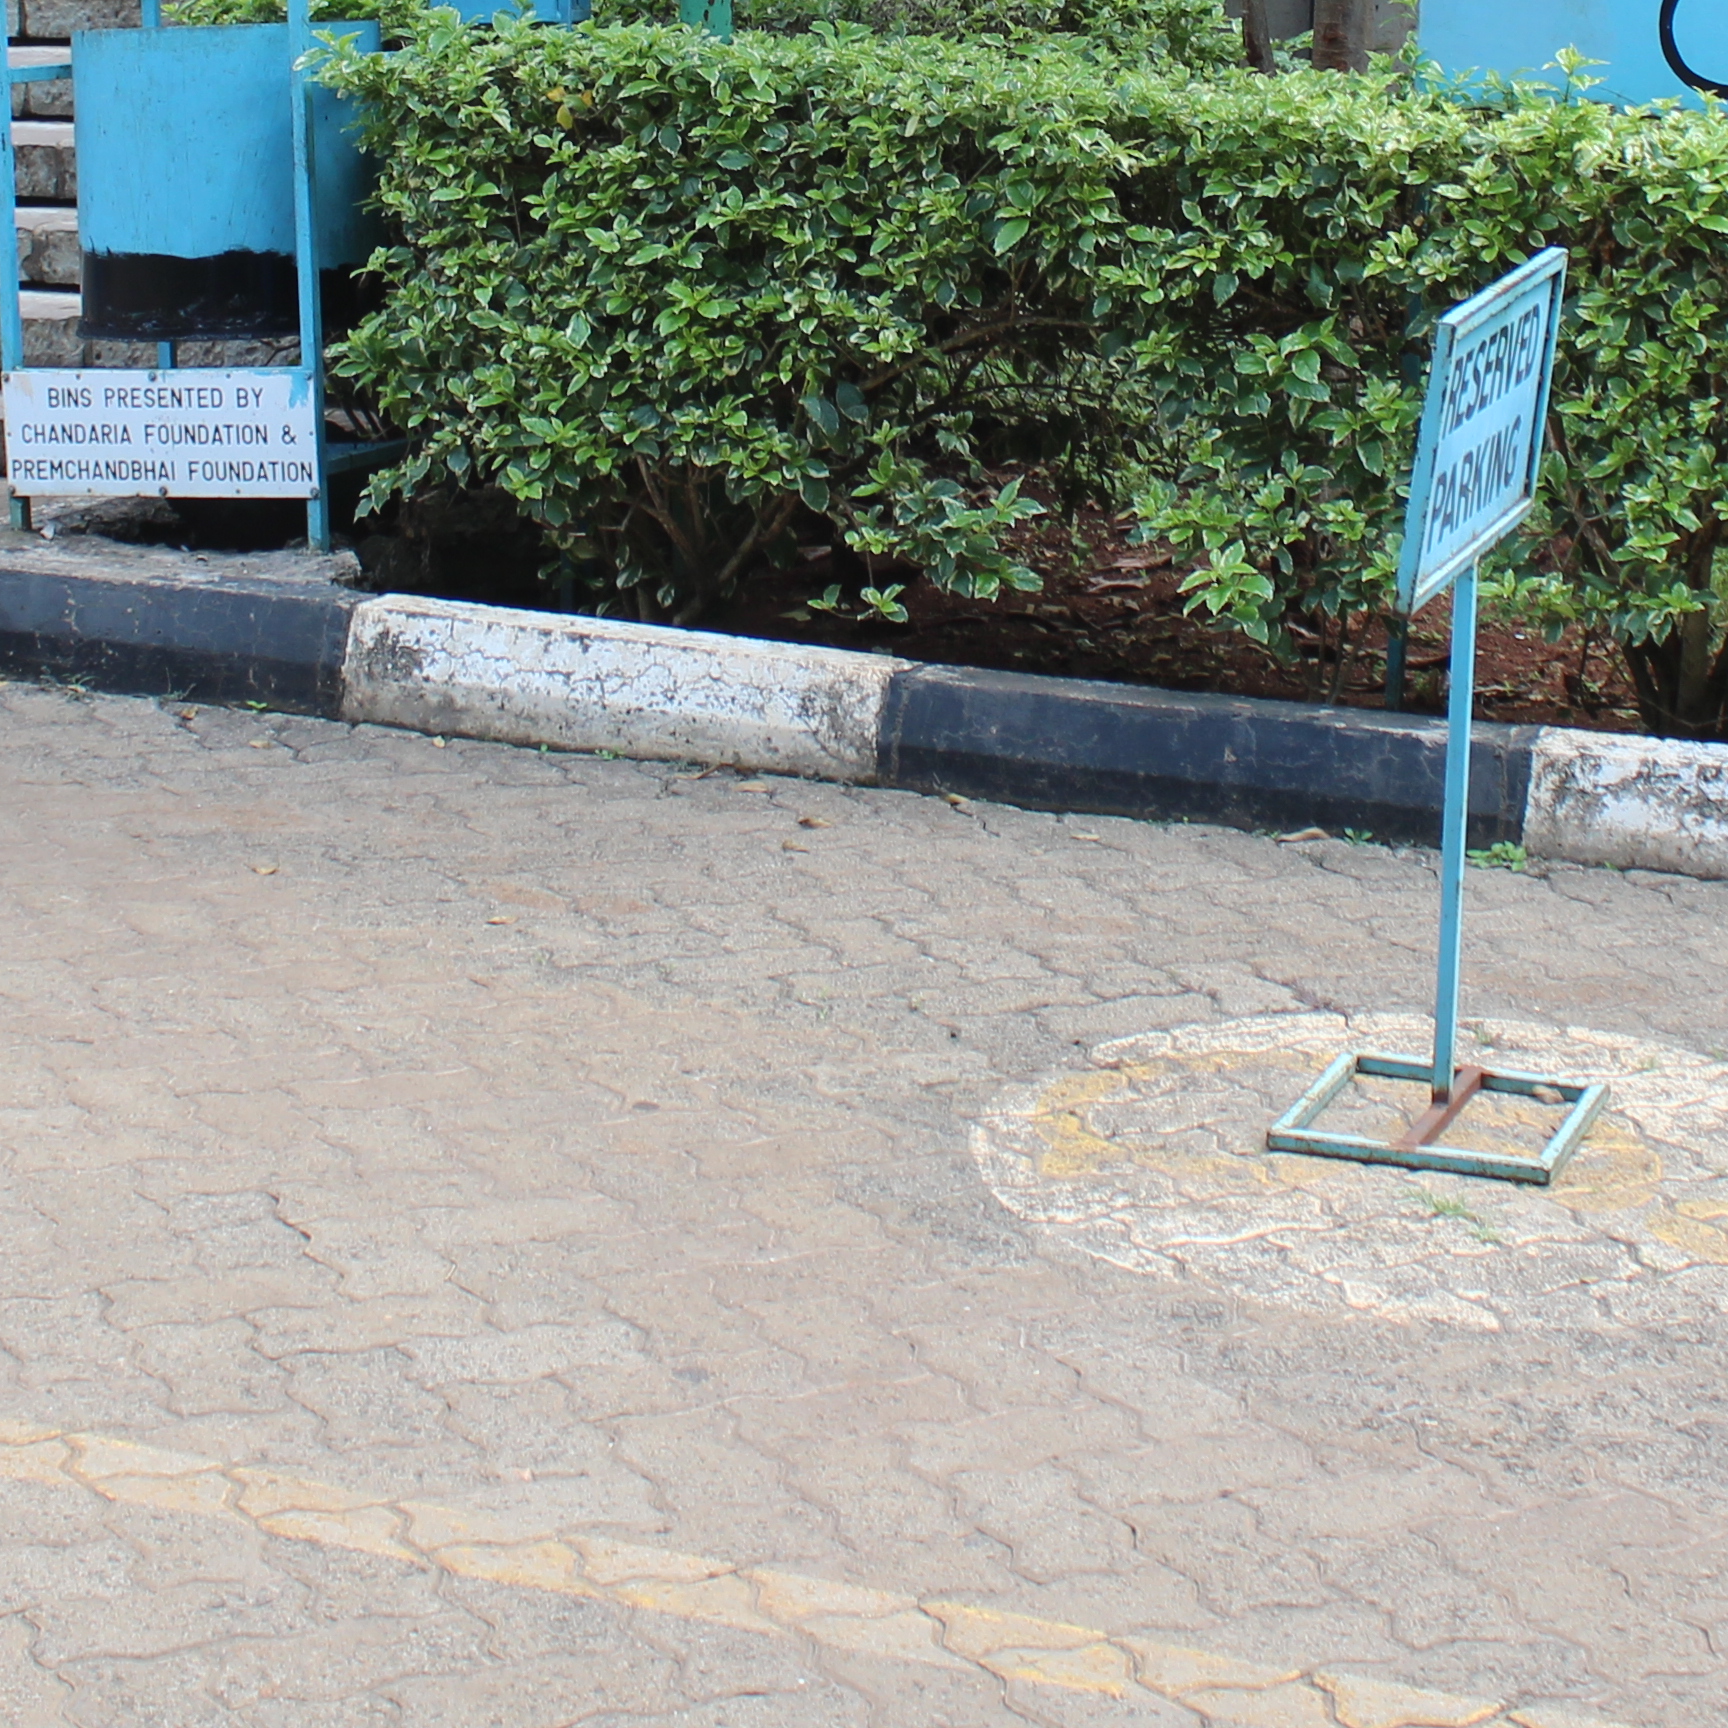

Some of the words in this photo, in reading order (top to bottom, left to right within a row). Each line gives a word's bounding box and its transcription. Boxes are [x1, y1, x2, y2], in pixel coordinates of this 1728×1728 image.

[1442, 303, 1540, 439] RESERVED
[47, 387, 92, 408] BINS
[104, 387, 223, 408] PRESENTED
[236, 387, 264, 408] BY
[21, 423, 132, 445] CHANDARIA
[144, 424, 268, 445] FOUNDATION
[281, 424, 296, 444] &
[12, 459, 175, 481] PREMCHANDBHAI
[188, 461, 313, 482] FOUNDATION
[1426, 414, 1522, 553] PARKING
